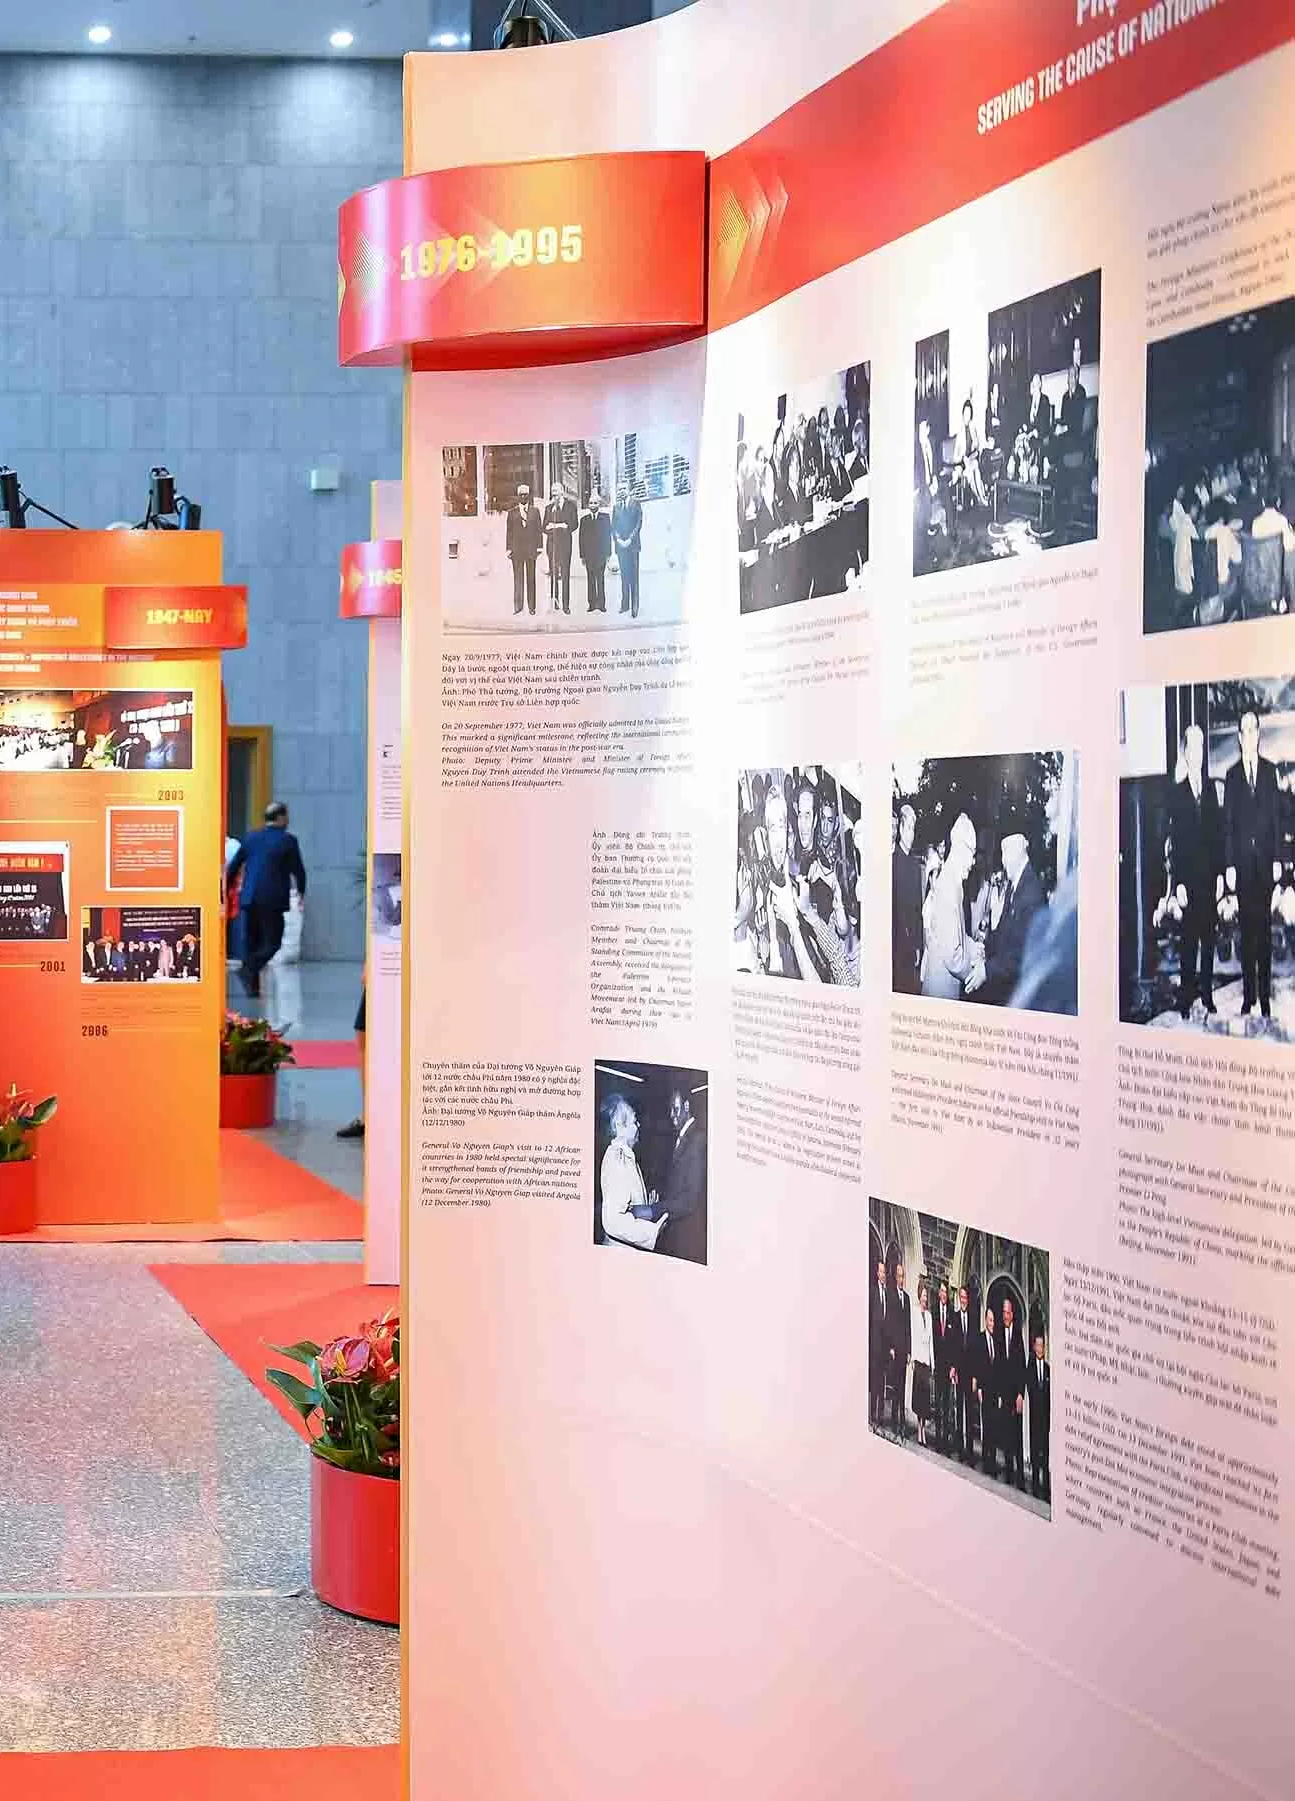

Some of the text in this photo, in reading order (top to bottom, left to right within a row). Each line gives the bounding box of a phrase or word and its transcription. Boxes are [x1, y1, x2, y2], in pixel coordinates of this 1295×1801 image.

[977, 76, 1035, 135] SERVING
[1037, 59, 1063, 102] THE
[1065, 31, 1115, 84] CAUSE
[1118, 18, 1138, 57] OF
[400, 224, 584, 281] 1976-1995
[465, 722, 503, 731] September
[578, 720, 607, 730] officially
[497, 734, 536, 742] significant
[577, 732, 609, 741] reflecting
[442, 745, 483, 754] recognition
[475, 757, 501, 765] Deputy
[472, 768, 487, 776] Duy
[562, 767, 601, 775] Vietnamese
[158, 790, 185, 801] 2003
[40, 961, 66, 972] 2001
[422, 1142, 450, 1150] General
[463, 1143, 490, 1151] Nguyen
[555, 1145, 581, 1153] African
[502, 1155, 526, 1164] special
[528, 1156, 569, 1166] significance
[570, 1158, 581, 1166] for
[429, 1165, 474, 1174] strengthened
[499, 1166, 507, 1175] of
[507, 1167, 543, 1176] friendship
[545, 1168, 558, 1176] and
[434, 1177, 449, 1185] way
[449, 1176, 460, 1185] for
[462, 1177, 505, 1186] cooperation
[524, 1178, 550, 1187] African
[485, 1189, 512, 1198] Nguyen
[514, 1189, 530, 1198] Giap
[556, 1192, 581, 1201] Angola
